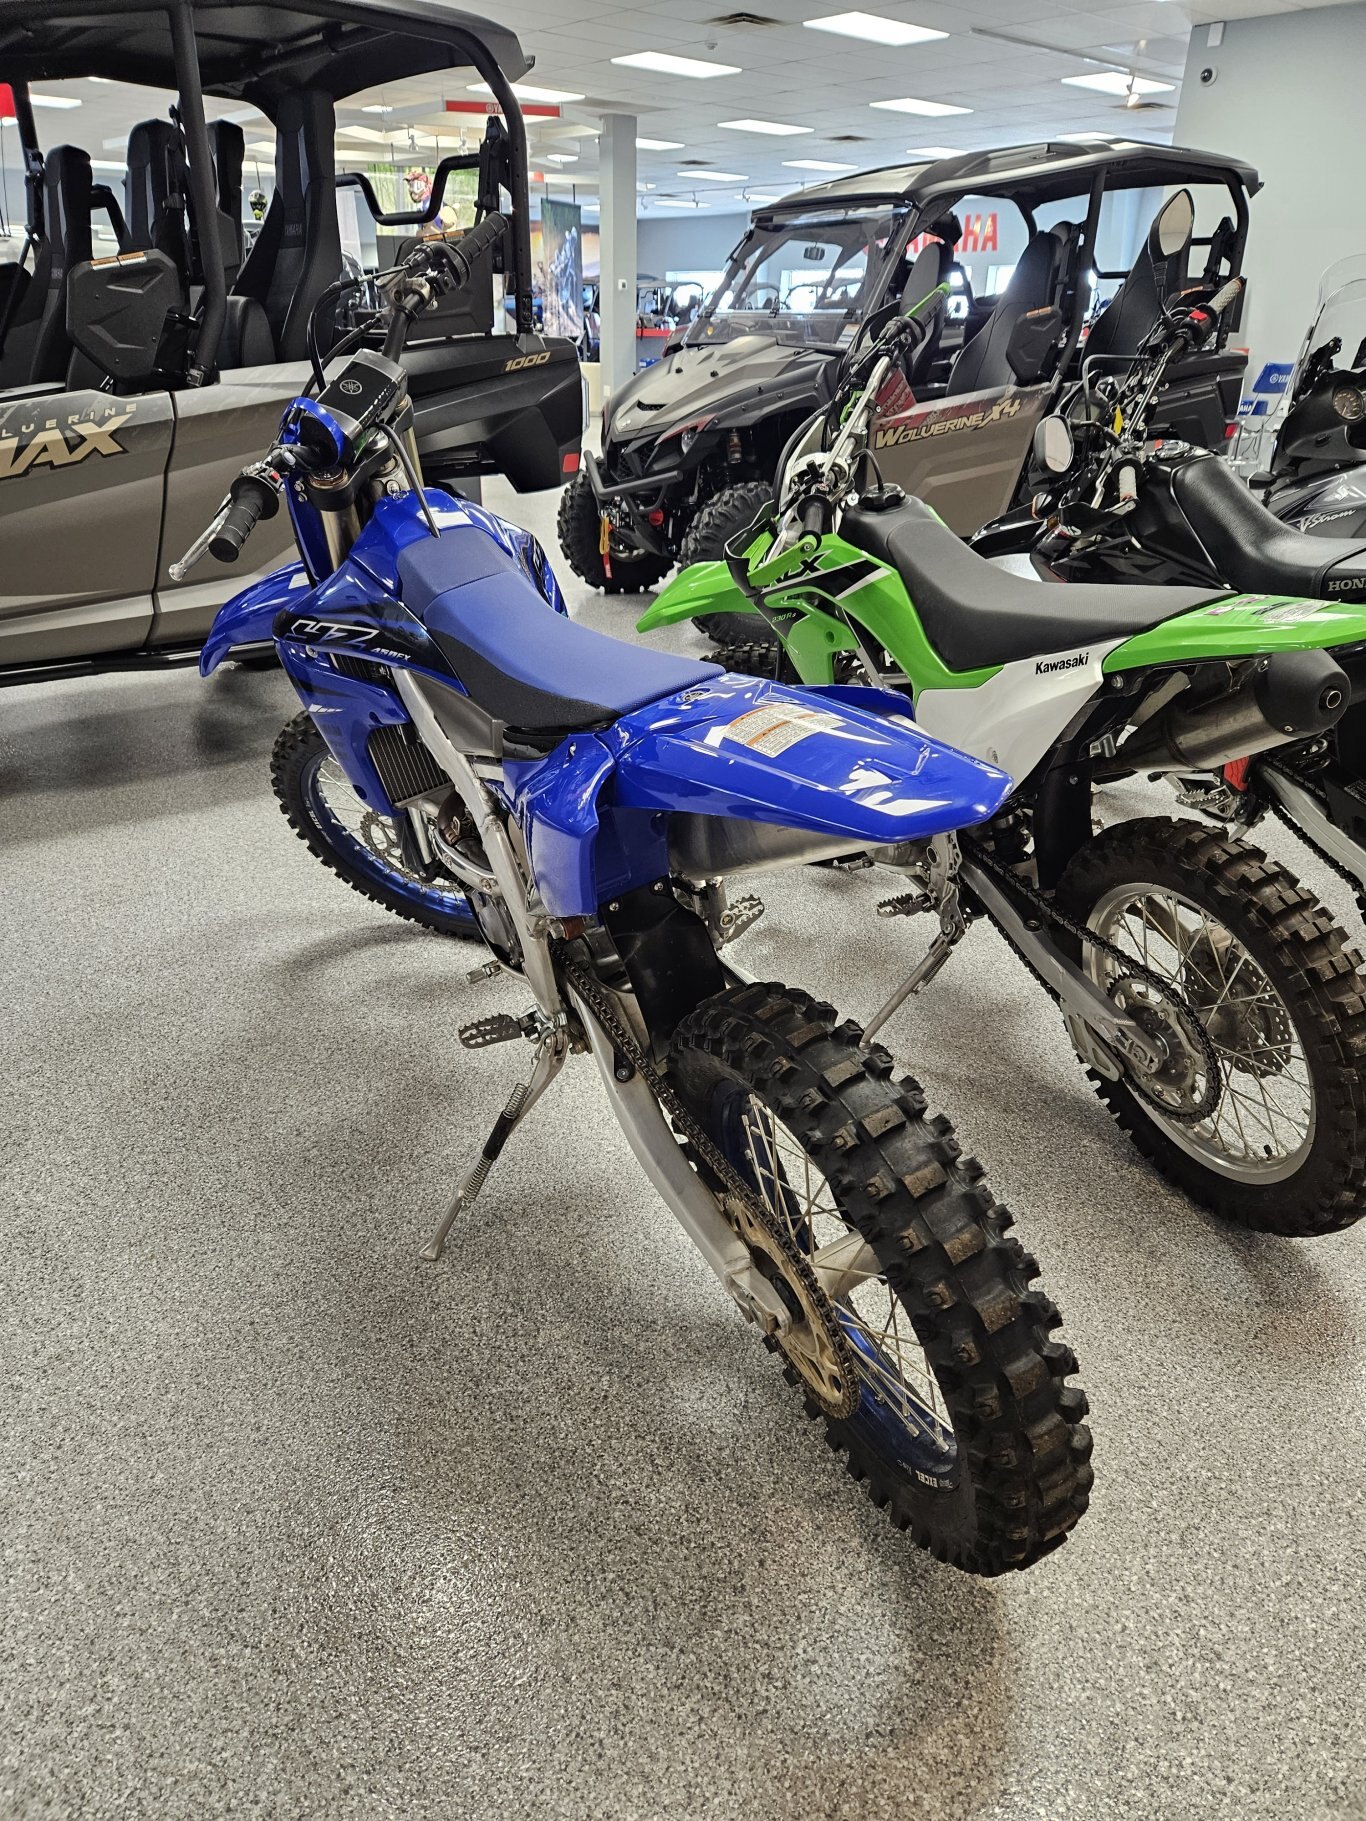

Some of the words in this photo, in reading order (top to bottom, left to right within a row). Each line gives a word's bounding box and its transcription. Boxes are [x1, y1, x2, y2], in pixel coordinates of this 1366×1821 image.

[505, 351, 551, 371] 1000
[979, 387, 1021, 428] X4
[1035, 652, 1090, 675] Kawasaki
[915, 1470, 939, 1488] EXCEL
